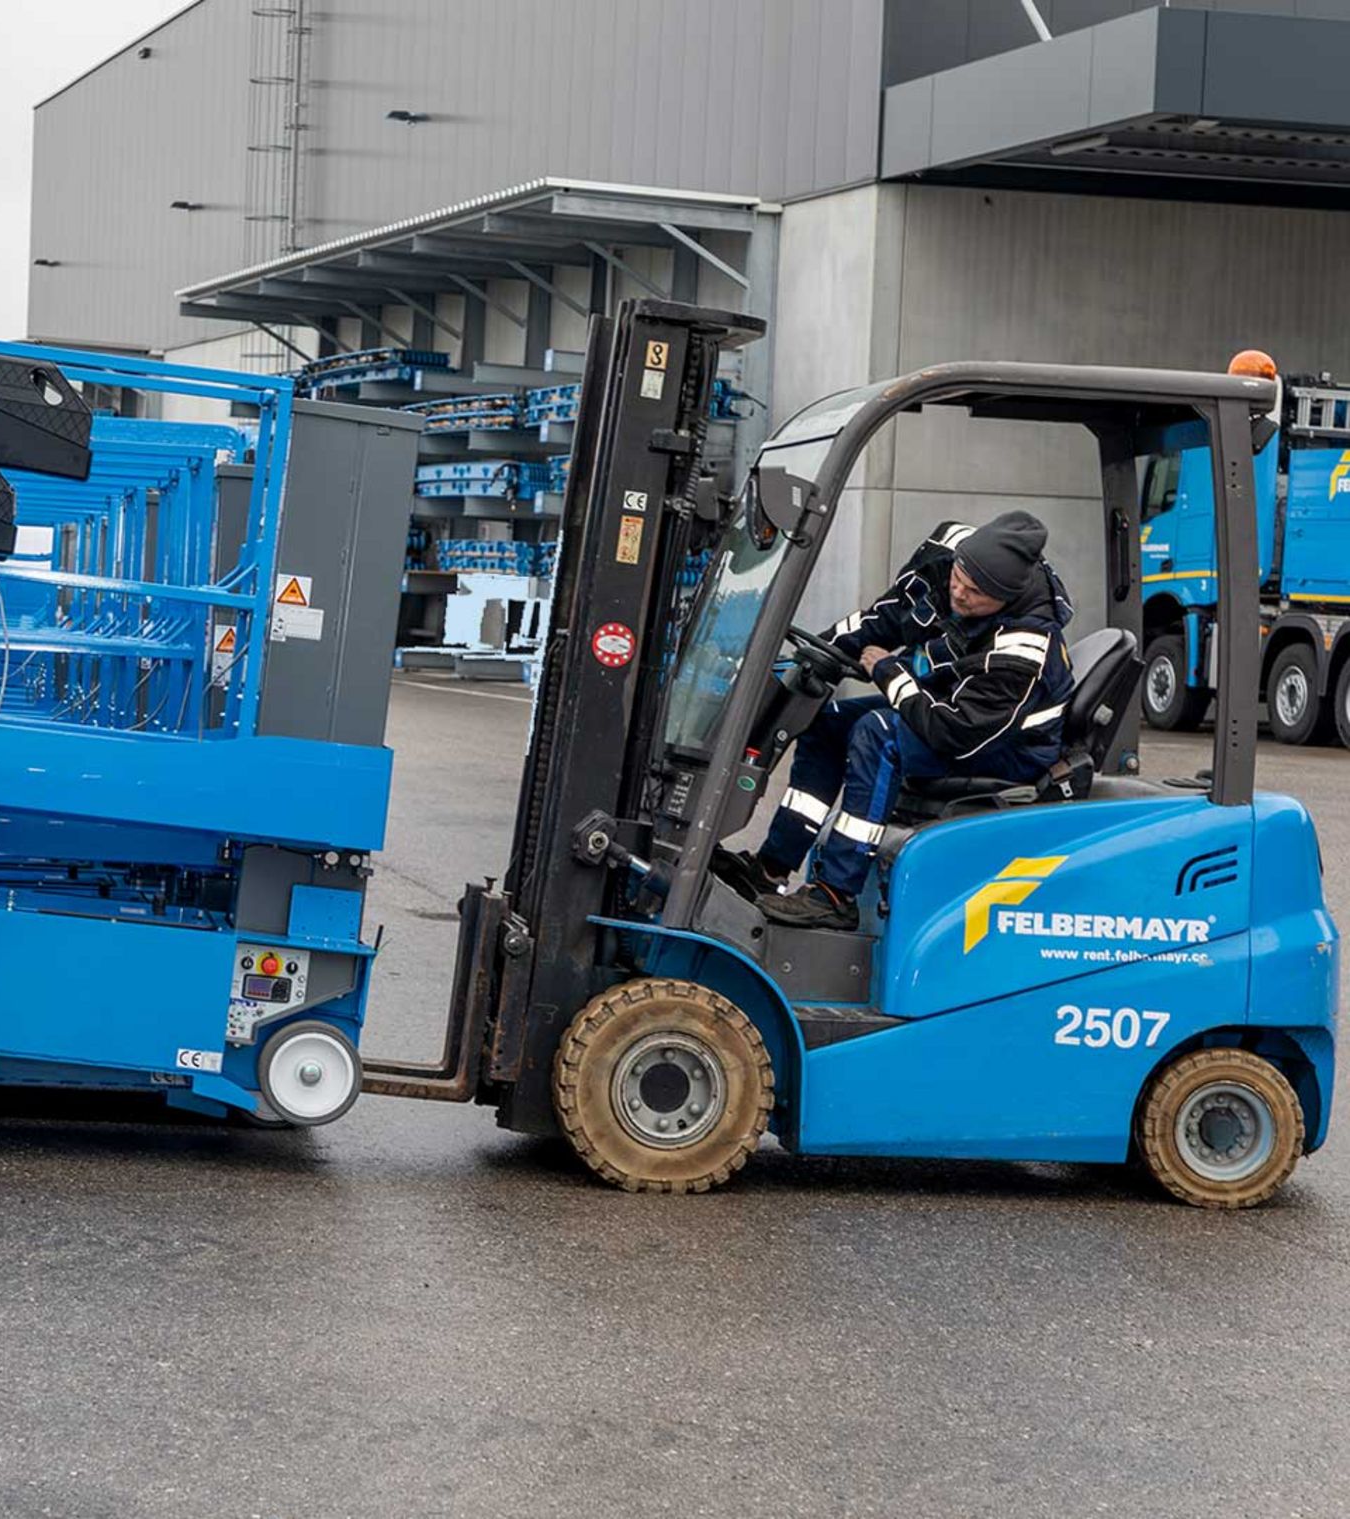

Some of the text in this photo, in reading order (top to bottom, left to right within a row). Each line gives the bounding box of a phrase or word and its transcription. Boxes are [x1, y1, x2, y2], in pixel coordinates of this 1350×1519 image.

[626, 493, 645, 509] CE
[1054, 1004, 1171, 1049] 2507
[179, 1050, 201, 1068] CE
